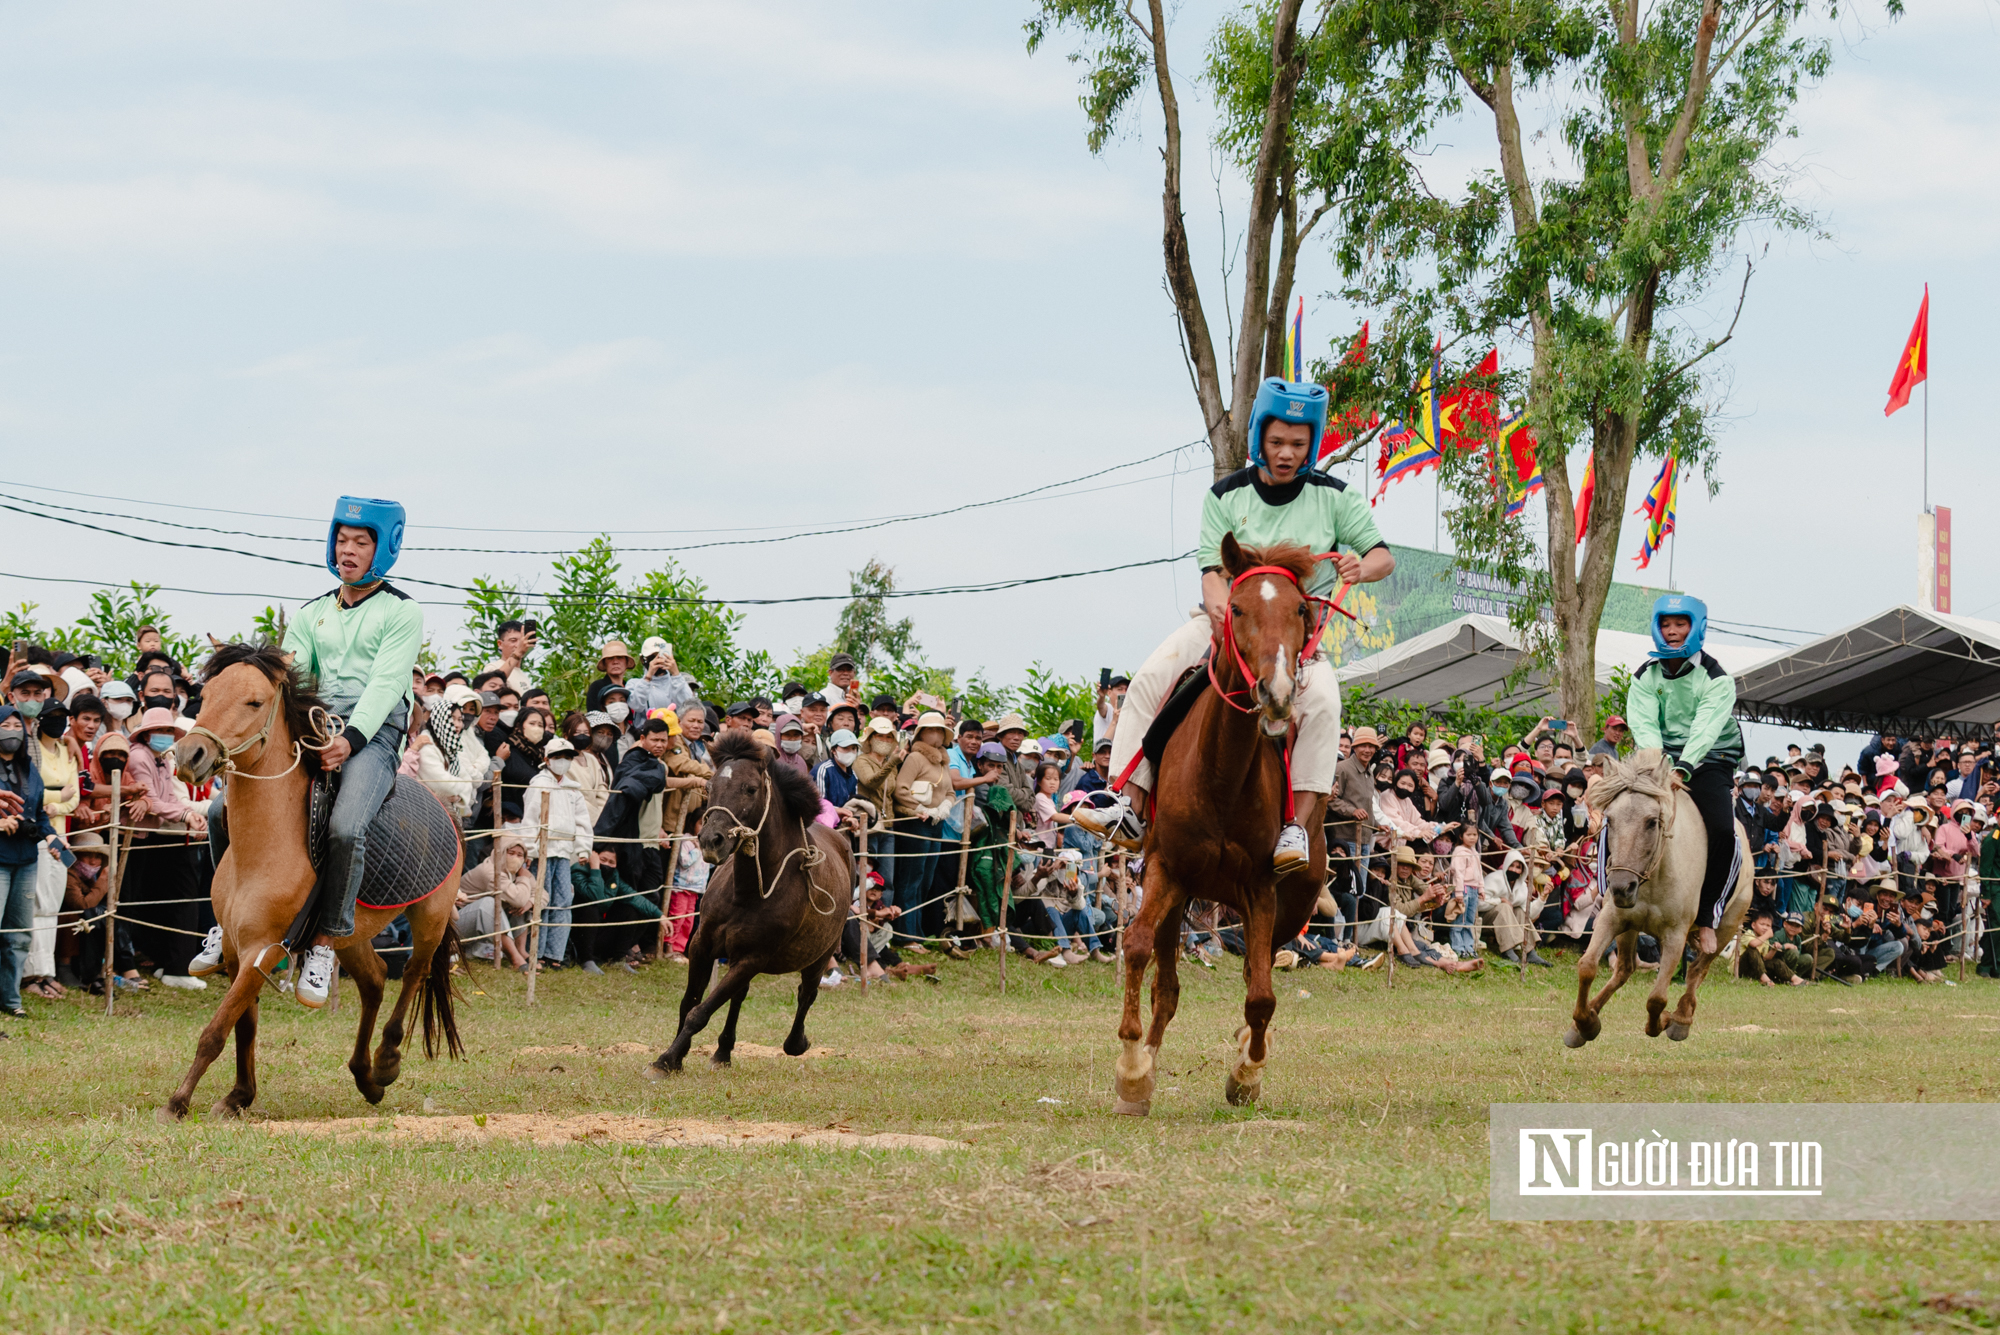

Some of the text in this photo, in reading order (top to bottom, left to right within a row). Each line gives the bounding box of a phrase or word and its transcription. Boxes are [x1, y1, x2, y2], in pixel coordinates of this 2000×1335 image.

[1467, 572, 1481, 589] BAN
[1452, 590, 1462, 611] SỞ
[1463, 594, 1477, 612] VĂN
[1479, 595, 1494, 616] HÓA,
